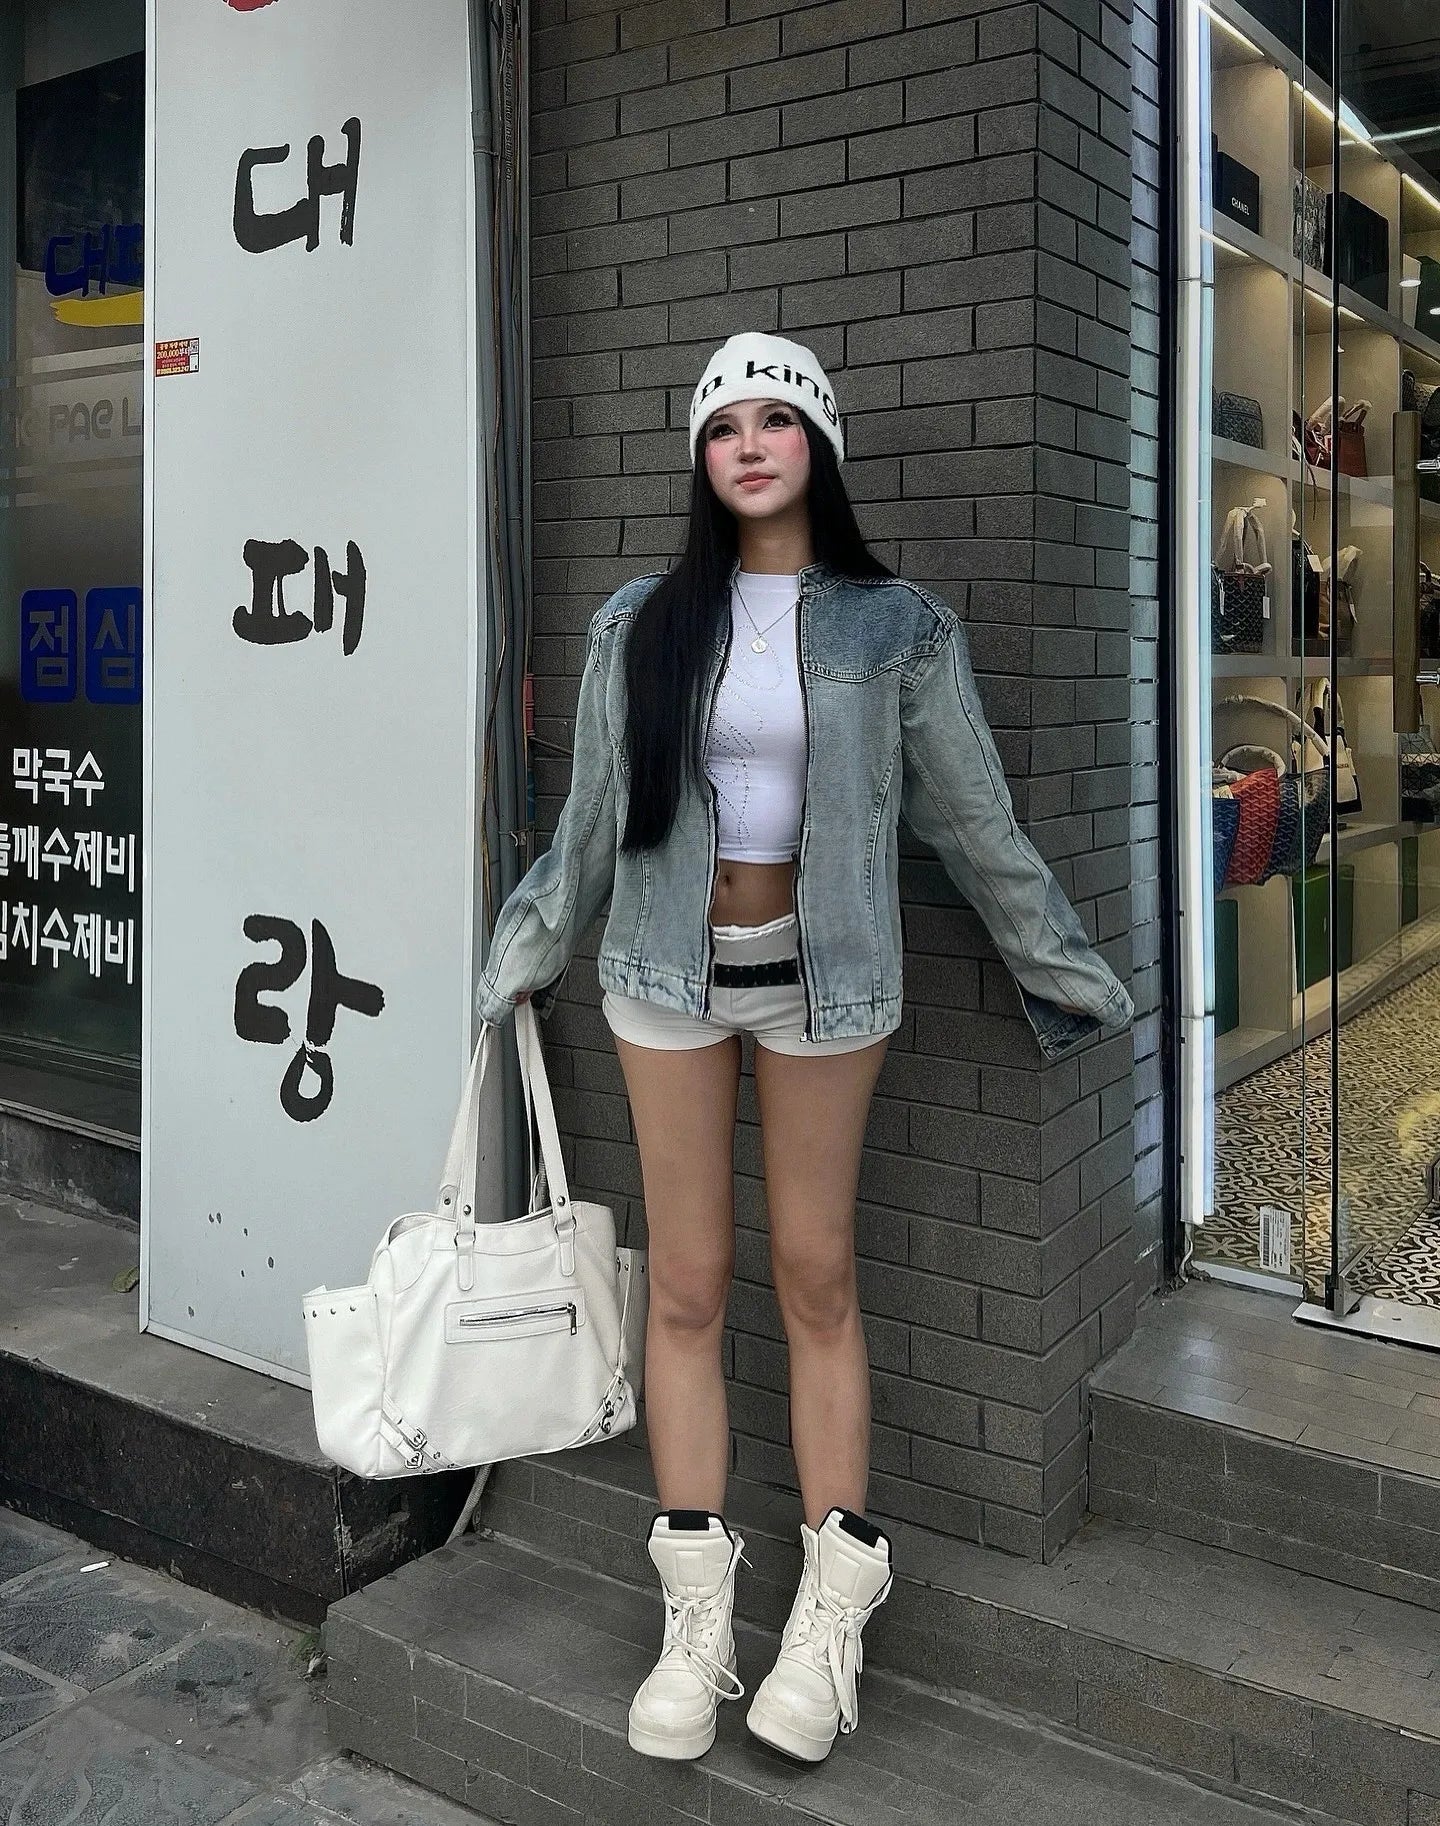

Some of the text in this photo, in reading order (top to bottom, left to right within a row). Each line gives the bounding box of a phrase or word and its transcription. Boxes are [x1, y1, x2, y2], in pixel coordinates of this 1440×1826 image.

[504, 72, 513, 97] days
[746, 361, 837, 426] king
[29, 604, 135, 688] 점심
[13, 748, 105, 807] 막국수
